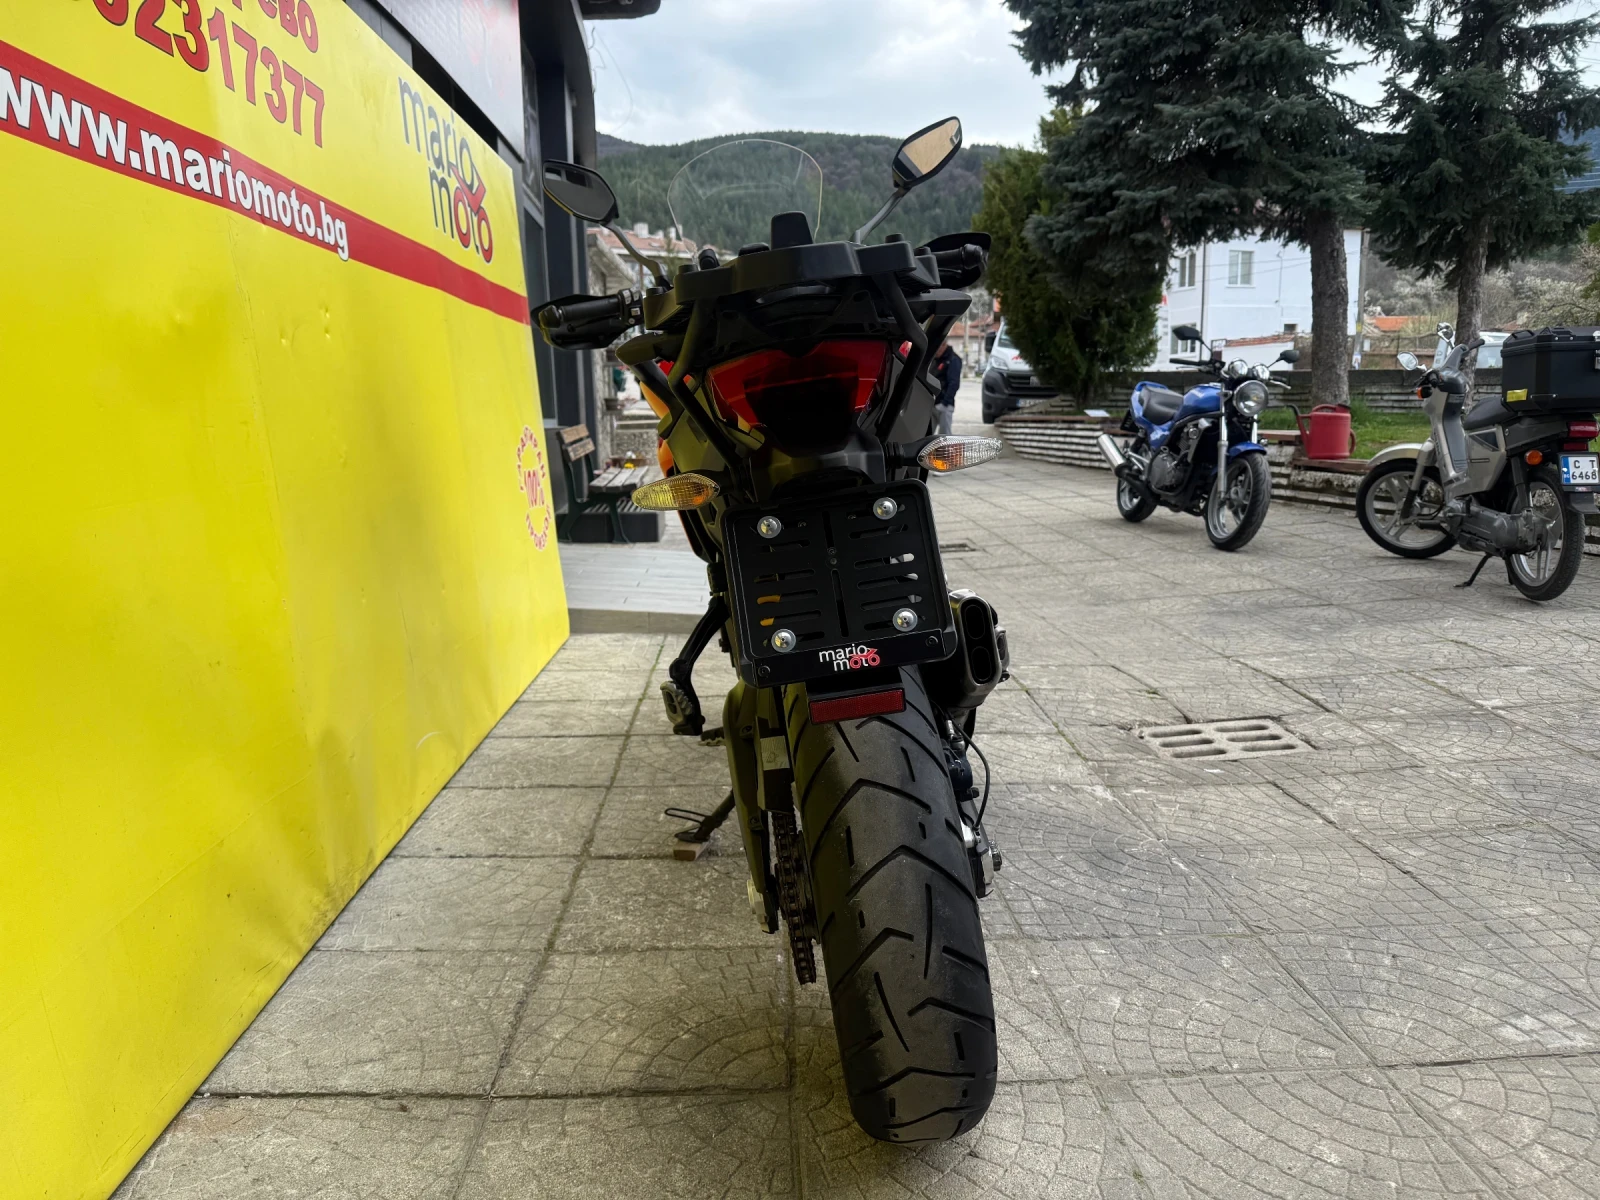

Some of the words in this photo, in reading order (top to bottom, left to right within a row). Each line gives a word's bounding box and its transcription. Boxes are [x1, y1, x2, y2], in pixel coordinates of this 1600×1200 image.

[398, 76, 475, 192] mario
[0, 66, 349, 262] www.mariomoto.bg
[428, 166, 493, 264] moto
[1571, 471, 1597, 480] 6468
[819, 644, 867, 662] mario
[833, 654, 880, 671] moto
